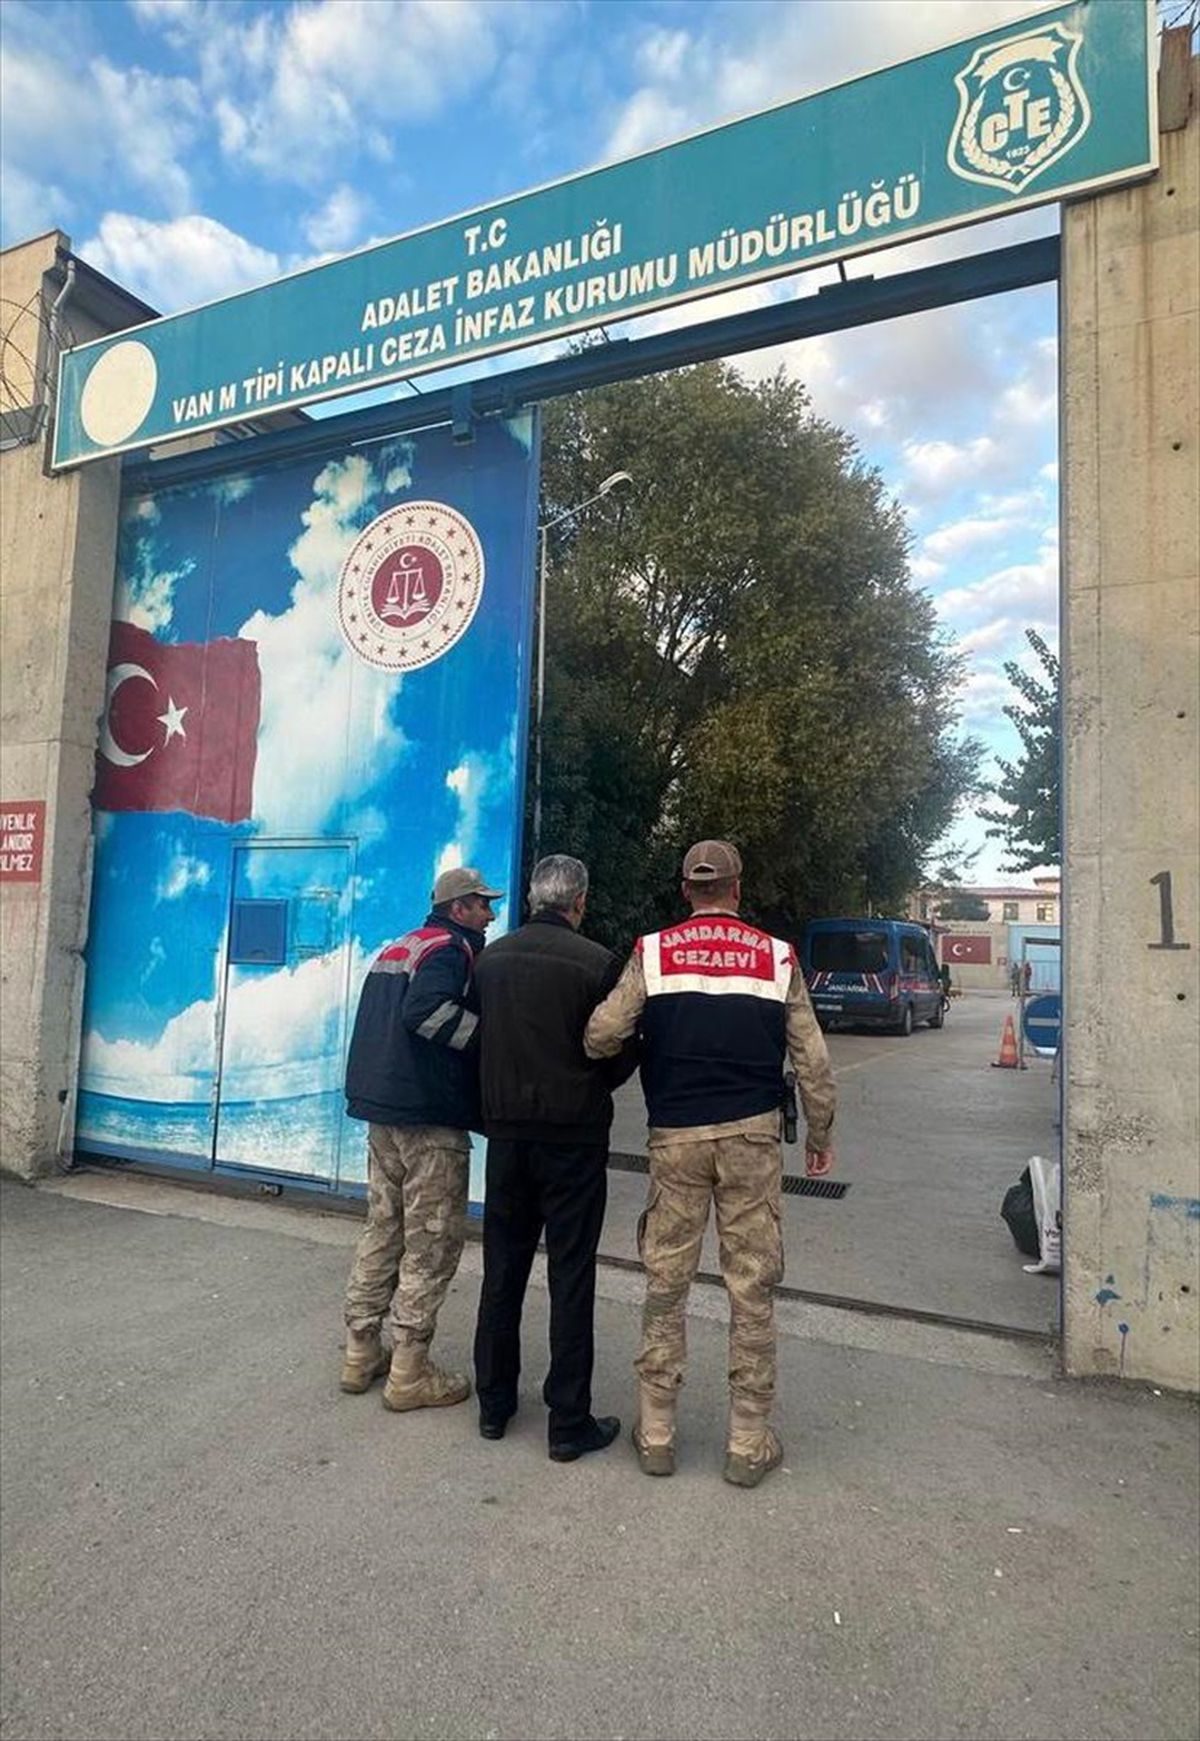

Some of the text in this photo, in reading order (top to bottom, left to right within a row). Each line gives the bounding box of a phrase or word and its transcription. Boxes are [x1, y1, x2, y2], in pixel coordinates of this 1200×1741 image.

[464, 218, 507, 255] T.C
[172, 173, 921, 424] VAN M TİPİ KAPALI CEZA İNFAZ KURUMU MÜDÜRLÜĞÜ
[361, 219, 622, 332] ADALET BAKANLIĞI
[662, 924, 771, 954] JANDARMA
[1147, 869, 1190, 950] 1
[672, 949, 757, 969] CEZAEVİ
